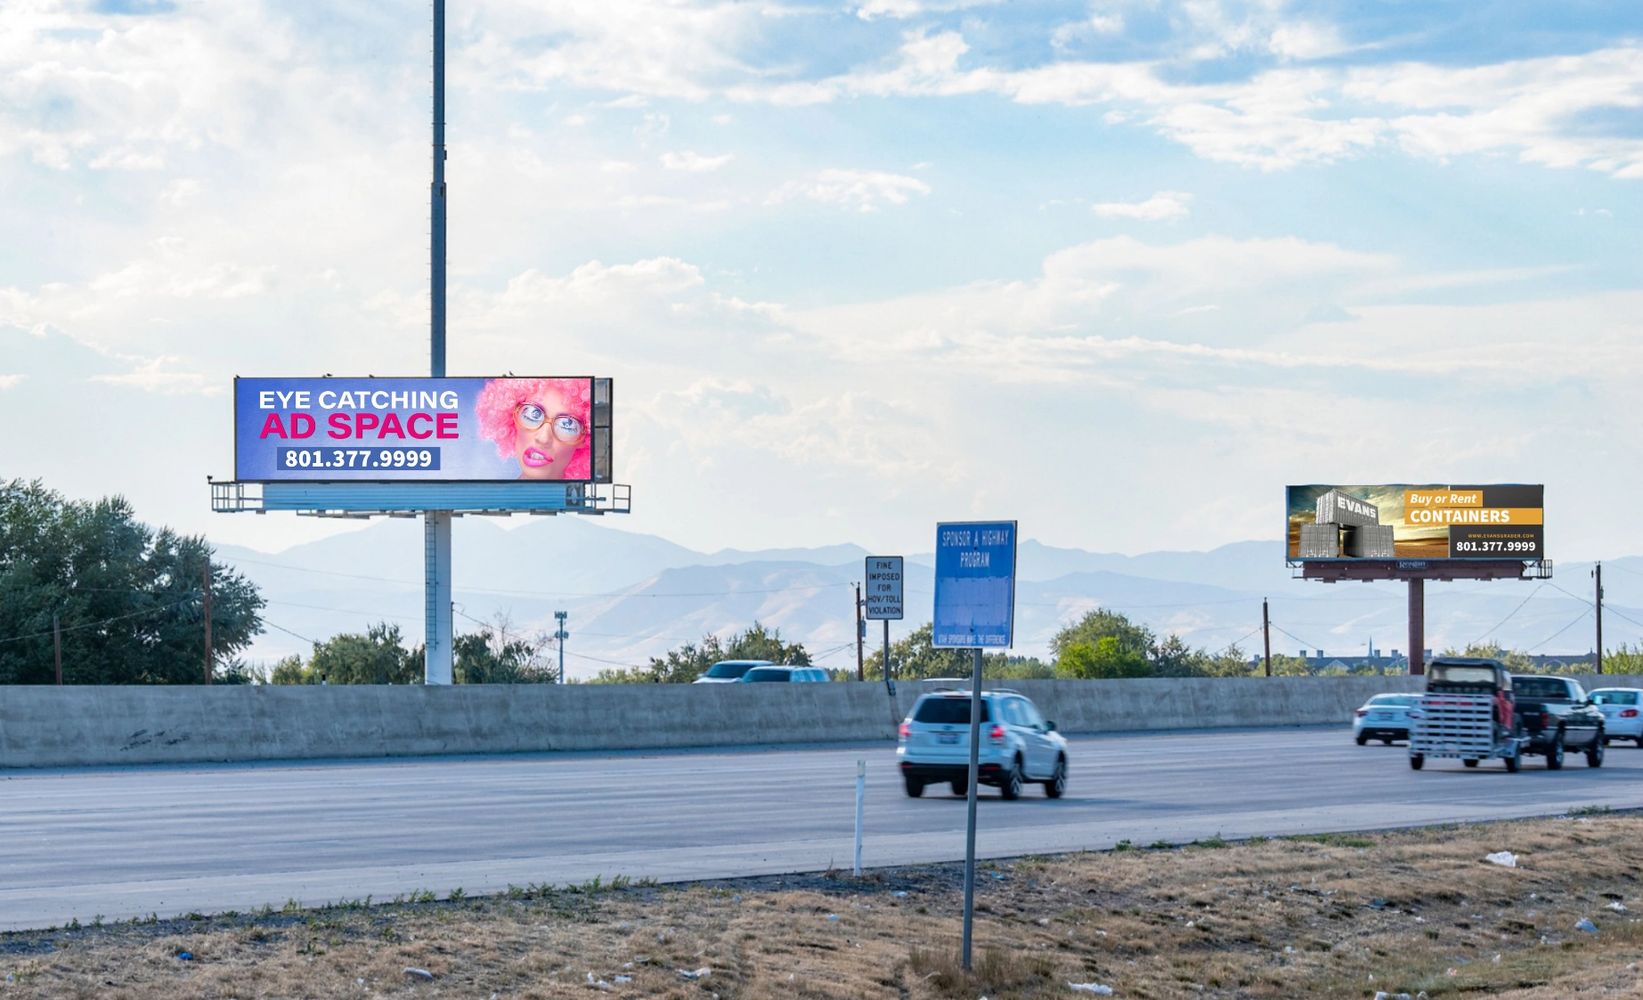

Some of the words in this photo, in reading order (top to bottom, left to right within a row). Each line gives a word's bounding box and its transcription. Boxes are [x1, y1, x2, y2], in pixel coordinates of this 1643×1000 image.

[259, 391, 310, 409] EYE
[318, 390, 458, 409] CATCHING
[259, 413, 316, 439] AD
[327, 412, 459, 439] SPACE
[285, 449, 432, 468] 801.377.9999
[1337, 495, 1376, 518] EVANS
[1410, 494, 1432, 506] Buy
[1434, 496, 1447, 504] or
[1449, 494, 1476, 504] Rent
[1410, 509, 1510, 523] CONTAINERS
[943, 531, 970, 547] SPONSOR
[974, 530, 979, 546] A
[982, 529, 1009, 545] HIGHWAY
[1456, 541, 1536, 551] 801.377.9999
[960, 551, 990, 568] PROGRAM
[869, 573, 900, 581] IMPOSED
[877, 584, 891, 592] FOR
[868, 595, 900, 603] HOV/TOLL
[869, 607, 901, 615] VIOLATION
